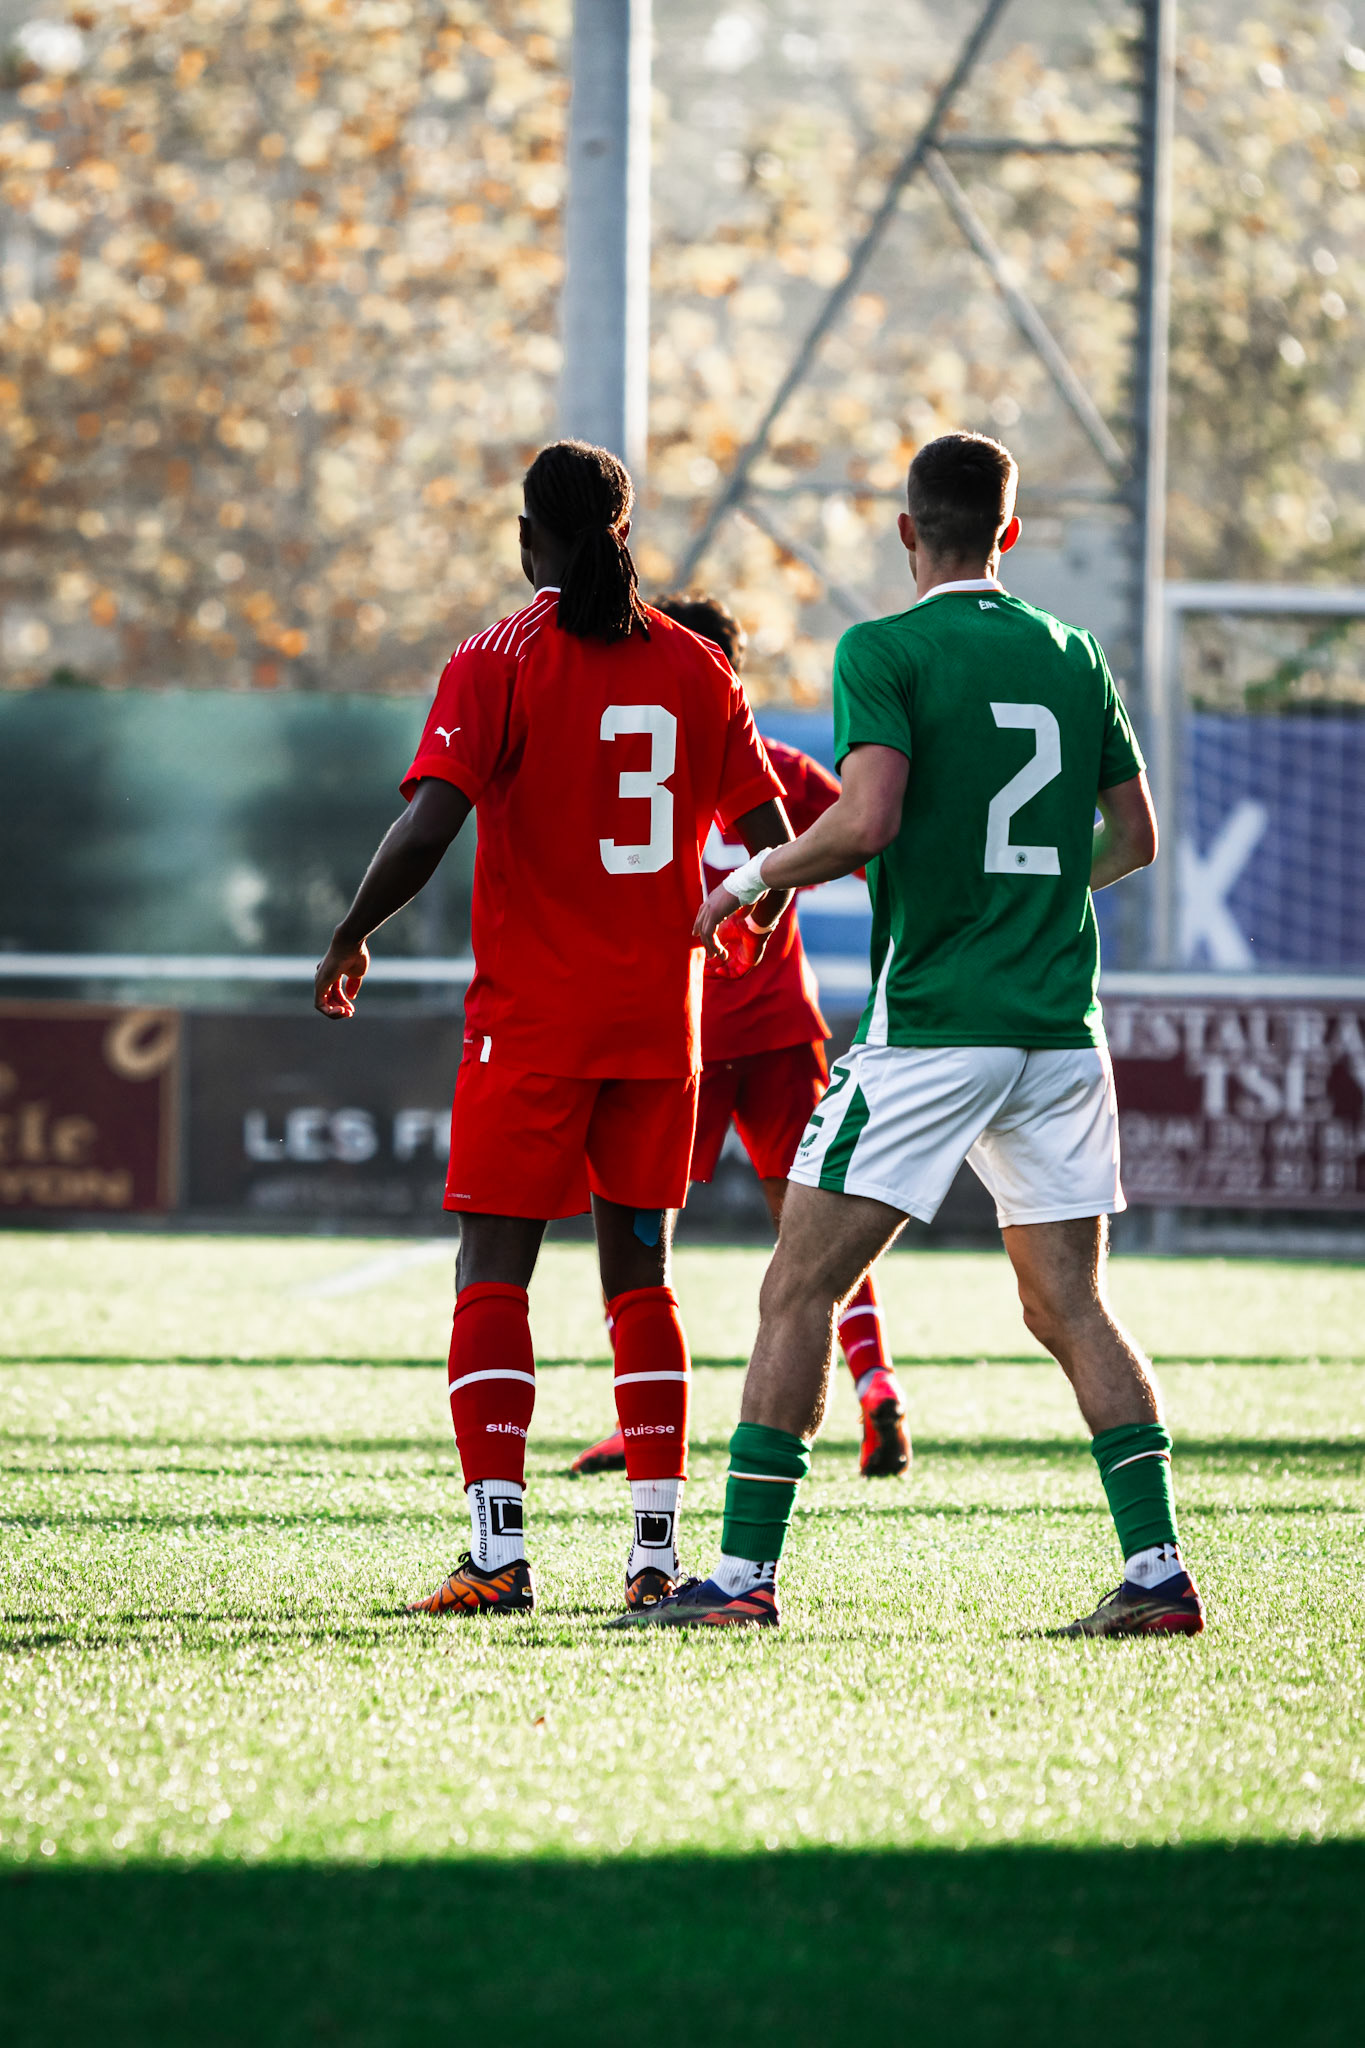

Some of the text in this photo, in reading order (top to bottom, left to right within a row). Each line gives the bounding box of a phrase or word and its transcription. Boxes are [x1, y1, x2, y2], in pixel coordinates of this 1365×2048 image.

[599, 704, 677, 875] 3
[984, 702, 1062, 876] 2
[243, 1106, 379, 1163] LES
[623, 1423, 676, 1438] suisse
[473, 1480, 488, 1563] TAPEDESIGN
